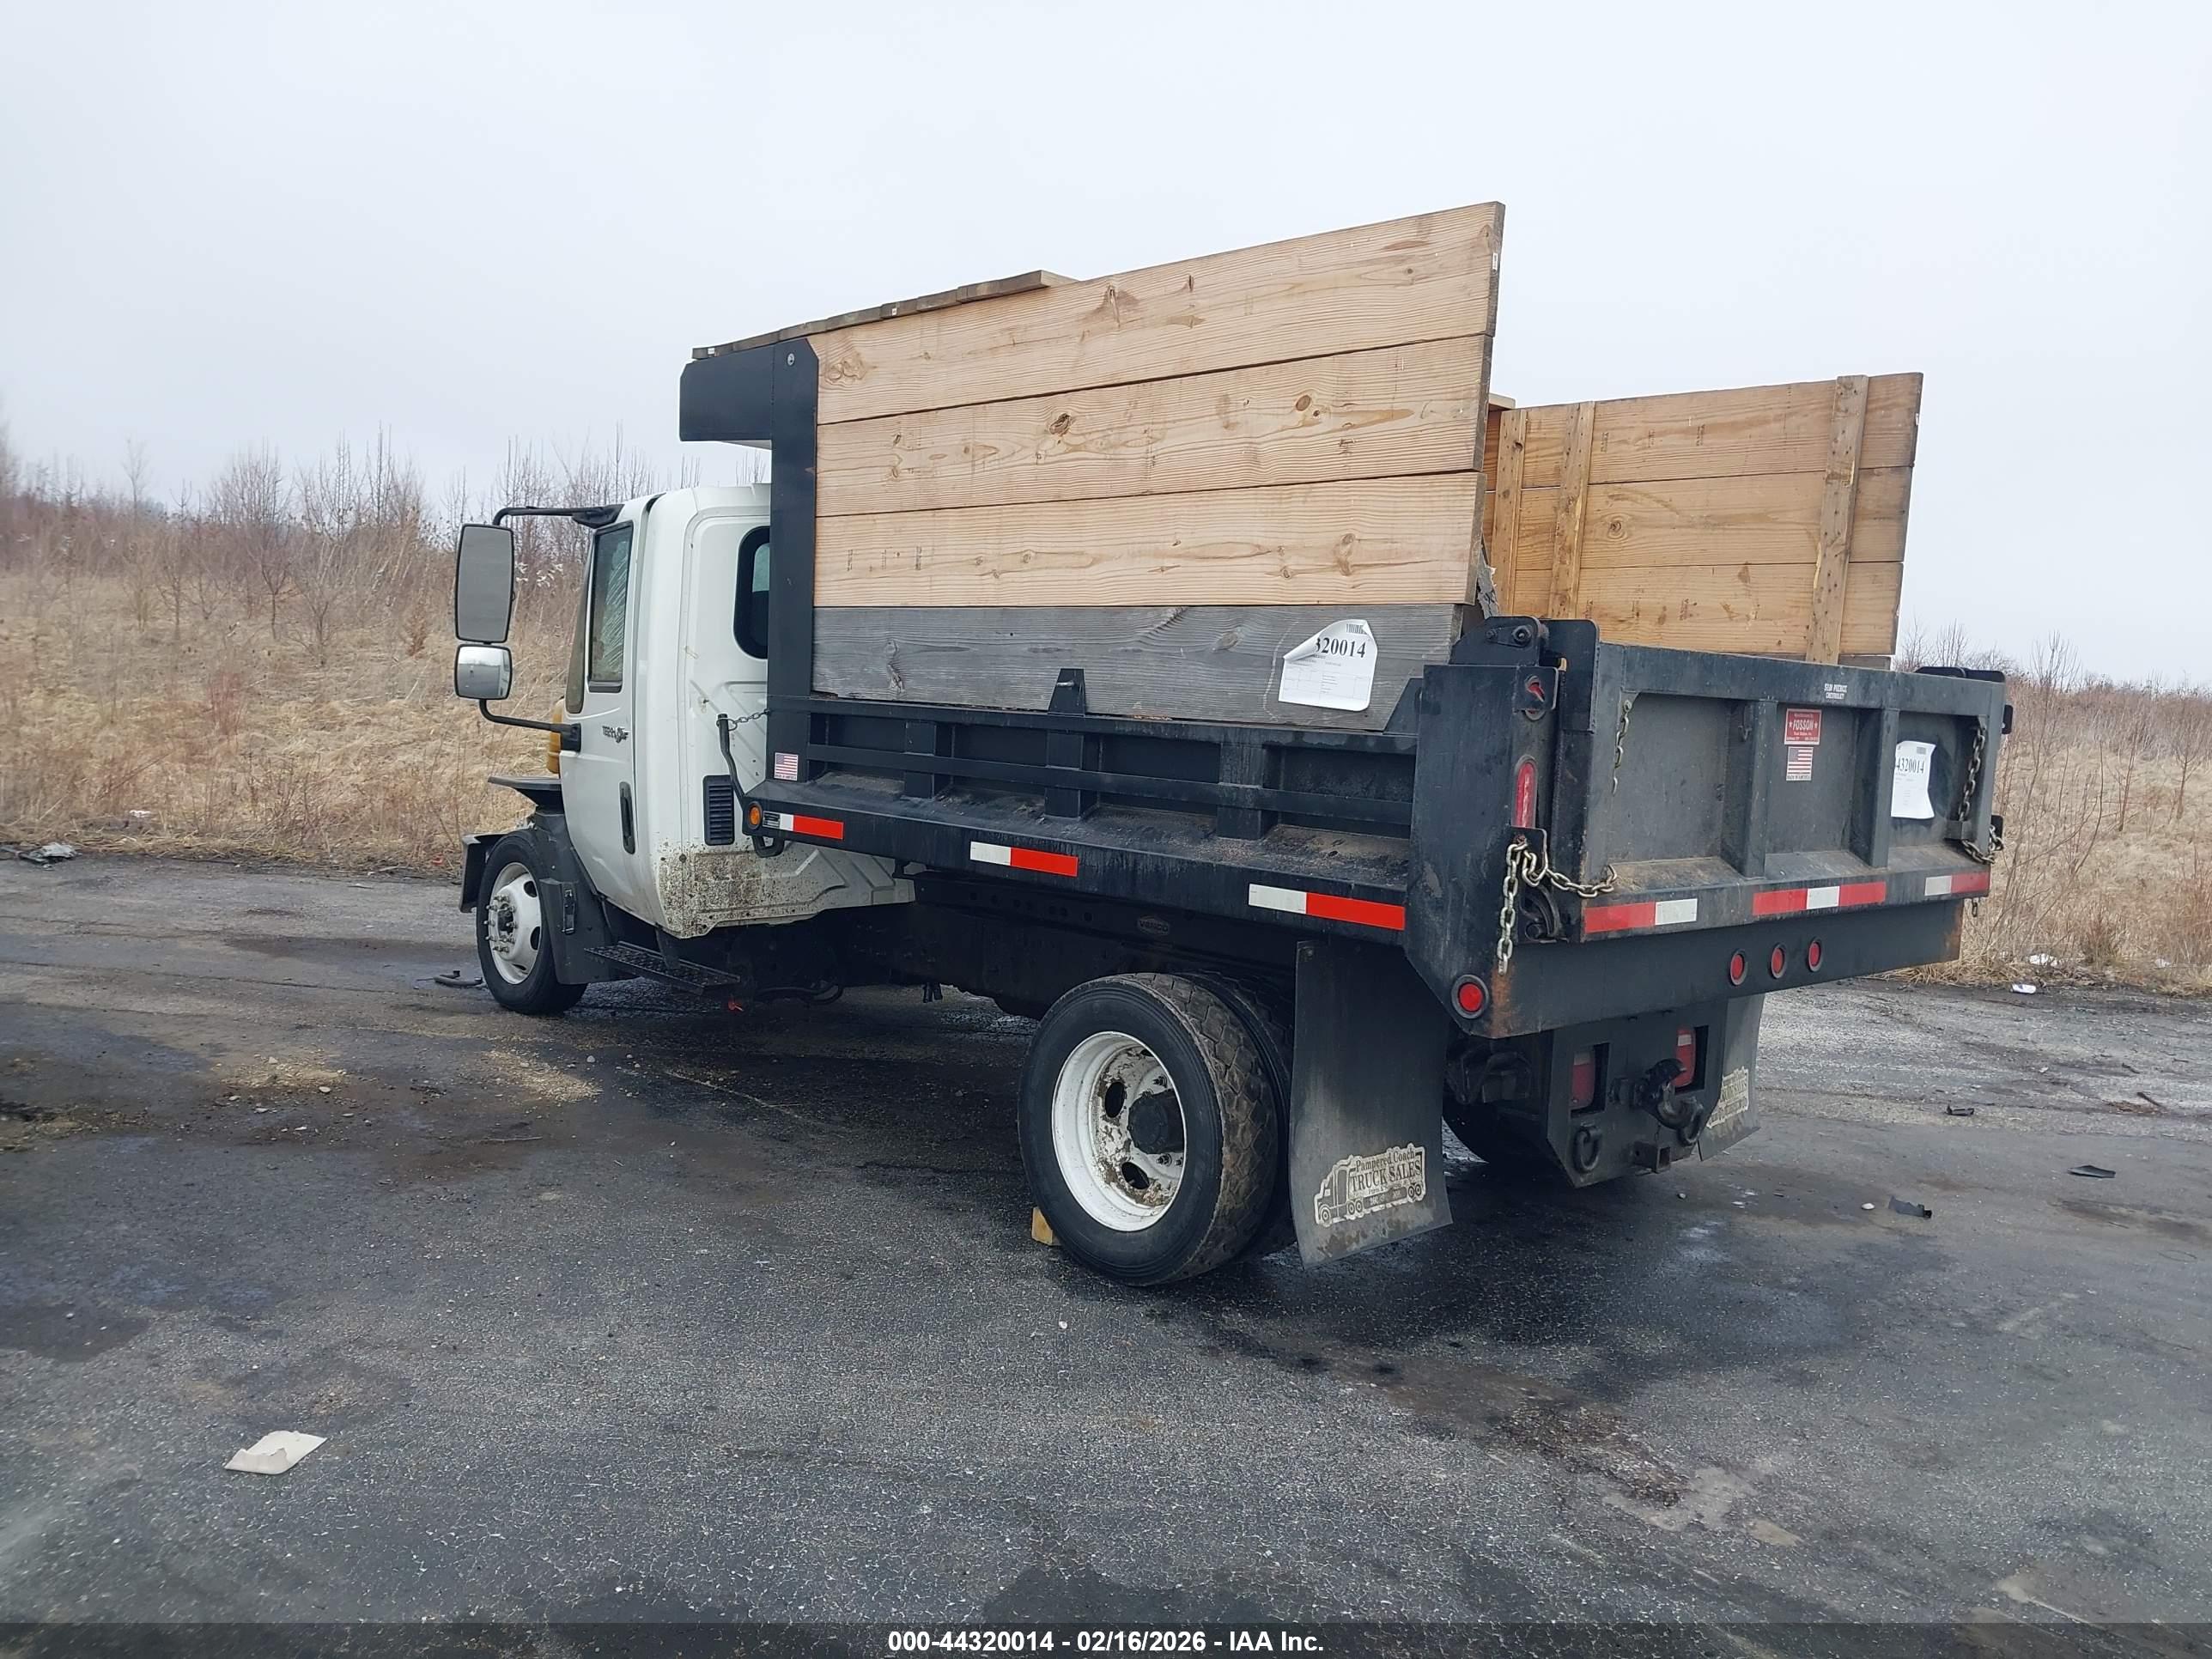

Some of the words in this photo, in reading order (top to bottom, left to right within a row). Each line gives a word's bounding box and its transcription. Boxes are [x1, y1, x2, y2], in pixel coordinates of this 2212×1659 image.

[1355, 1155, 1392, 1173] Pampered
[1394, 1147, 1416, 1163] Coach
[1350, 1169, 1388, 1192] TRUCK
[1389, 1159, 1422, 1182] SALES
